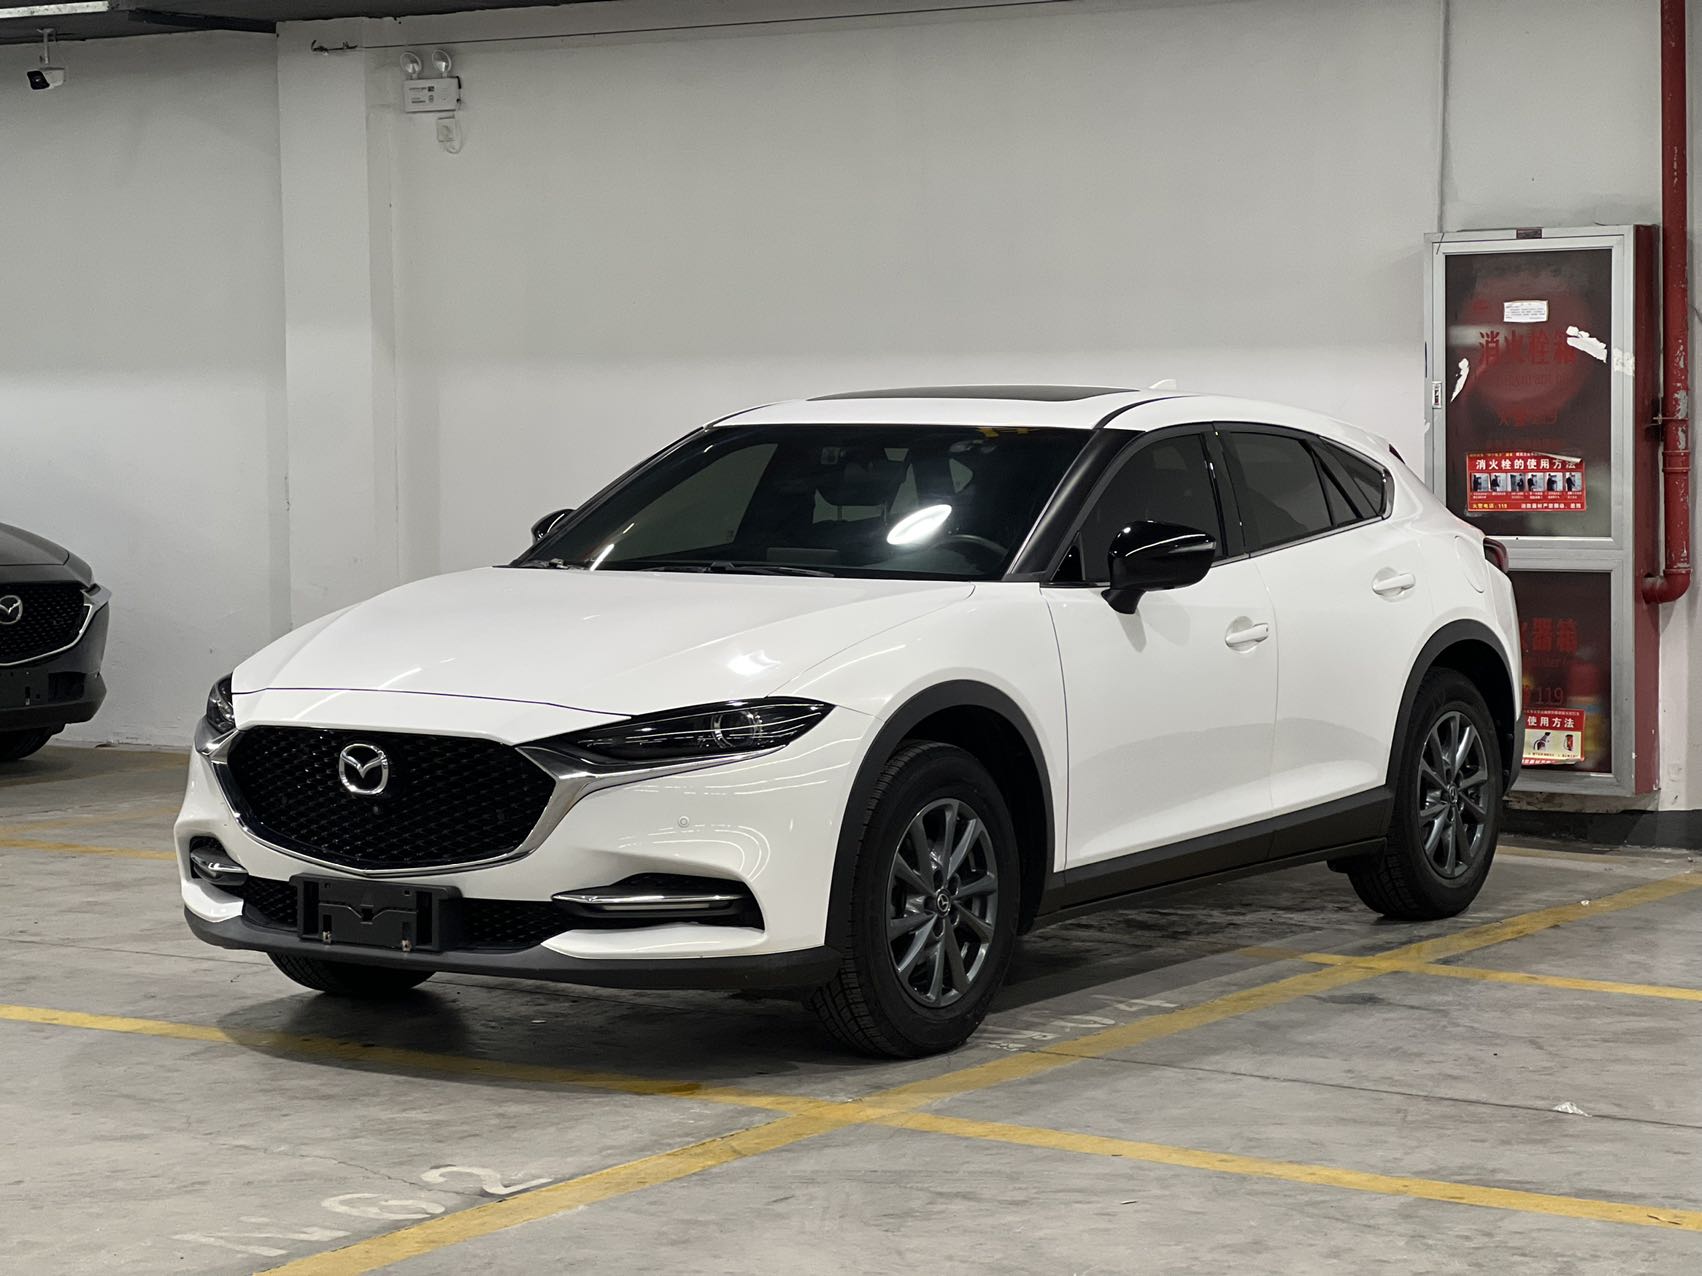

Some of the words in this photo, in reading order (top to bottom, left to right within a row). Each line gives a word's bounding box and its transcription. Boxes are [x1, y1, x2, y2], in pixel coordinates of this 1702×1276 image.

[1476, 458, 1577, 470] 消火栓的使用方法
[1527, 716, 1575, 728] 使用方法
